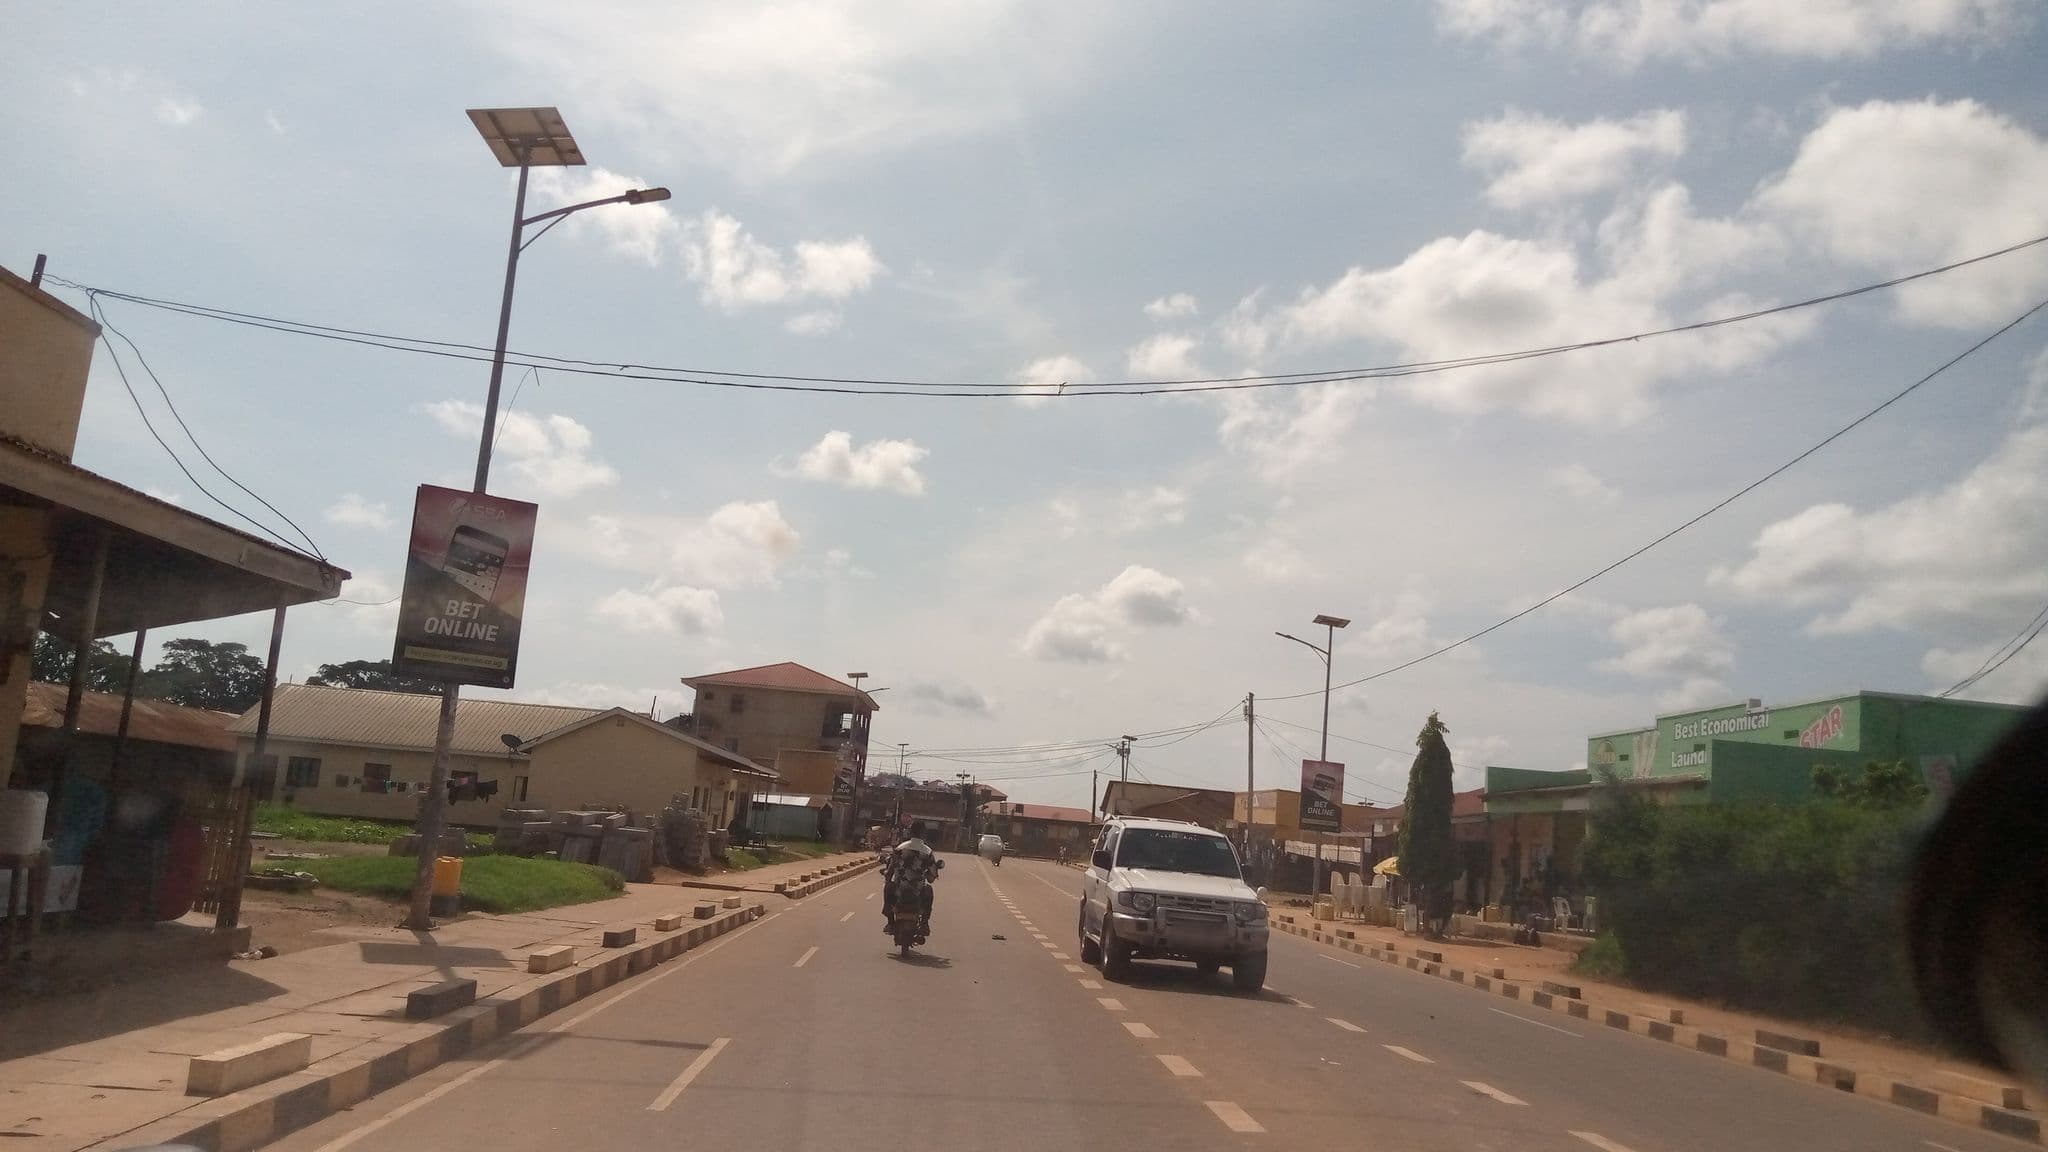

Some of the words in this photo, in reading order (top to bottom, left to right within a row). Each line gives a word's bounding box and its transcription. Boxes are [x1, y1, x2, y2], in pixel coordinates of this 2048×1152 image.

[444, 599, 486, 620] BET
[424, 617, 499, 642] ONLINE
[1673, 720, 1698, 740] Best
[1701, 711, 1769, 737] Economical
[1799, 704, 1843, 749] STAR
[1307, 807, 1335, 817] ONLINE
[1313, 800, 1328, 808] BET
